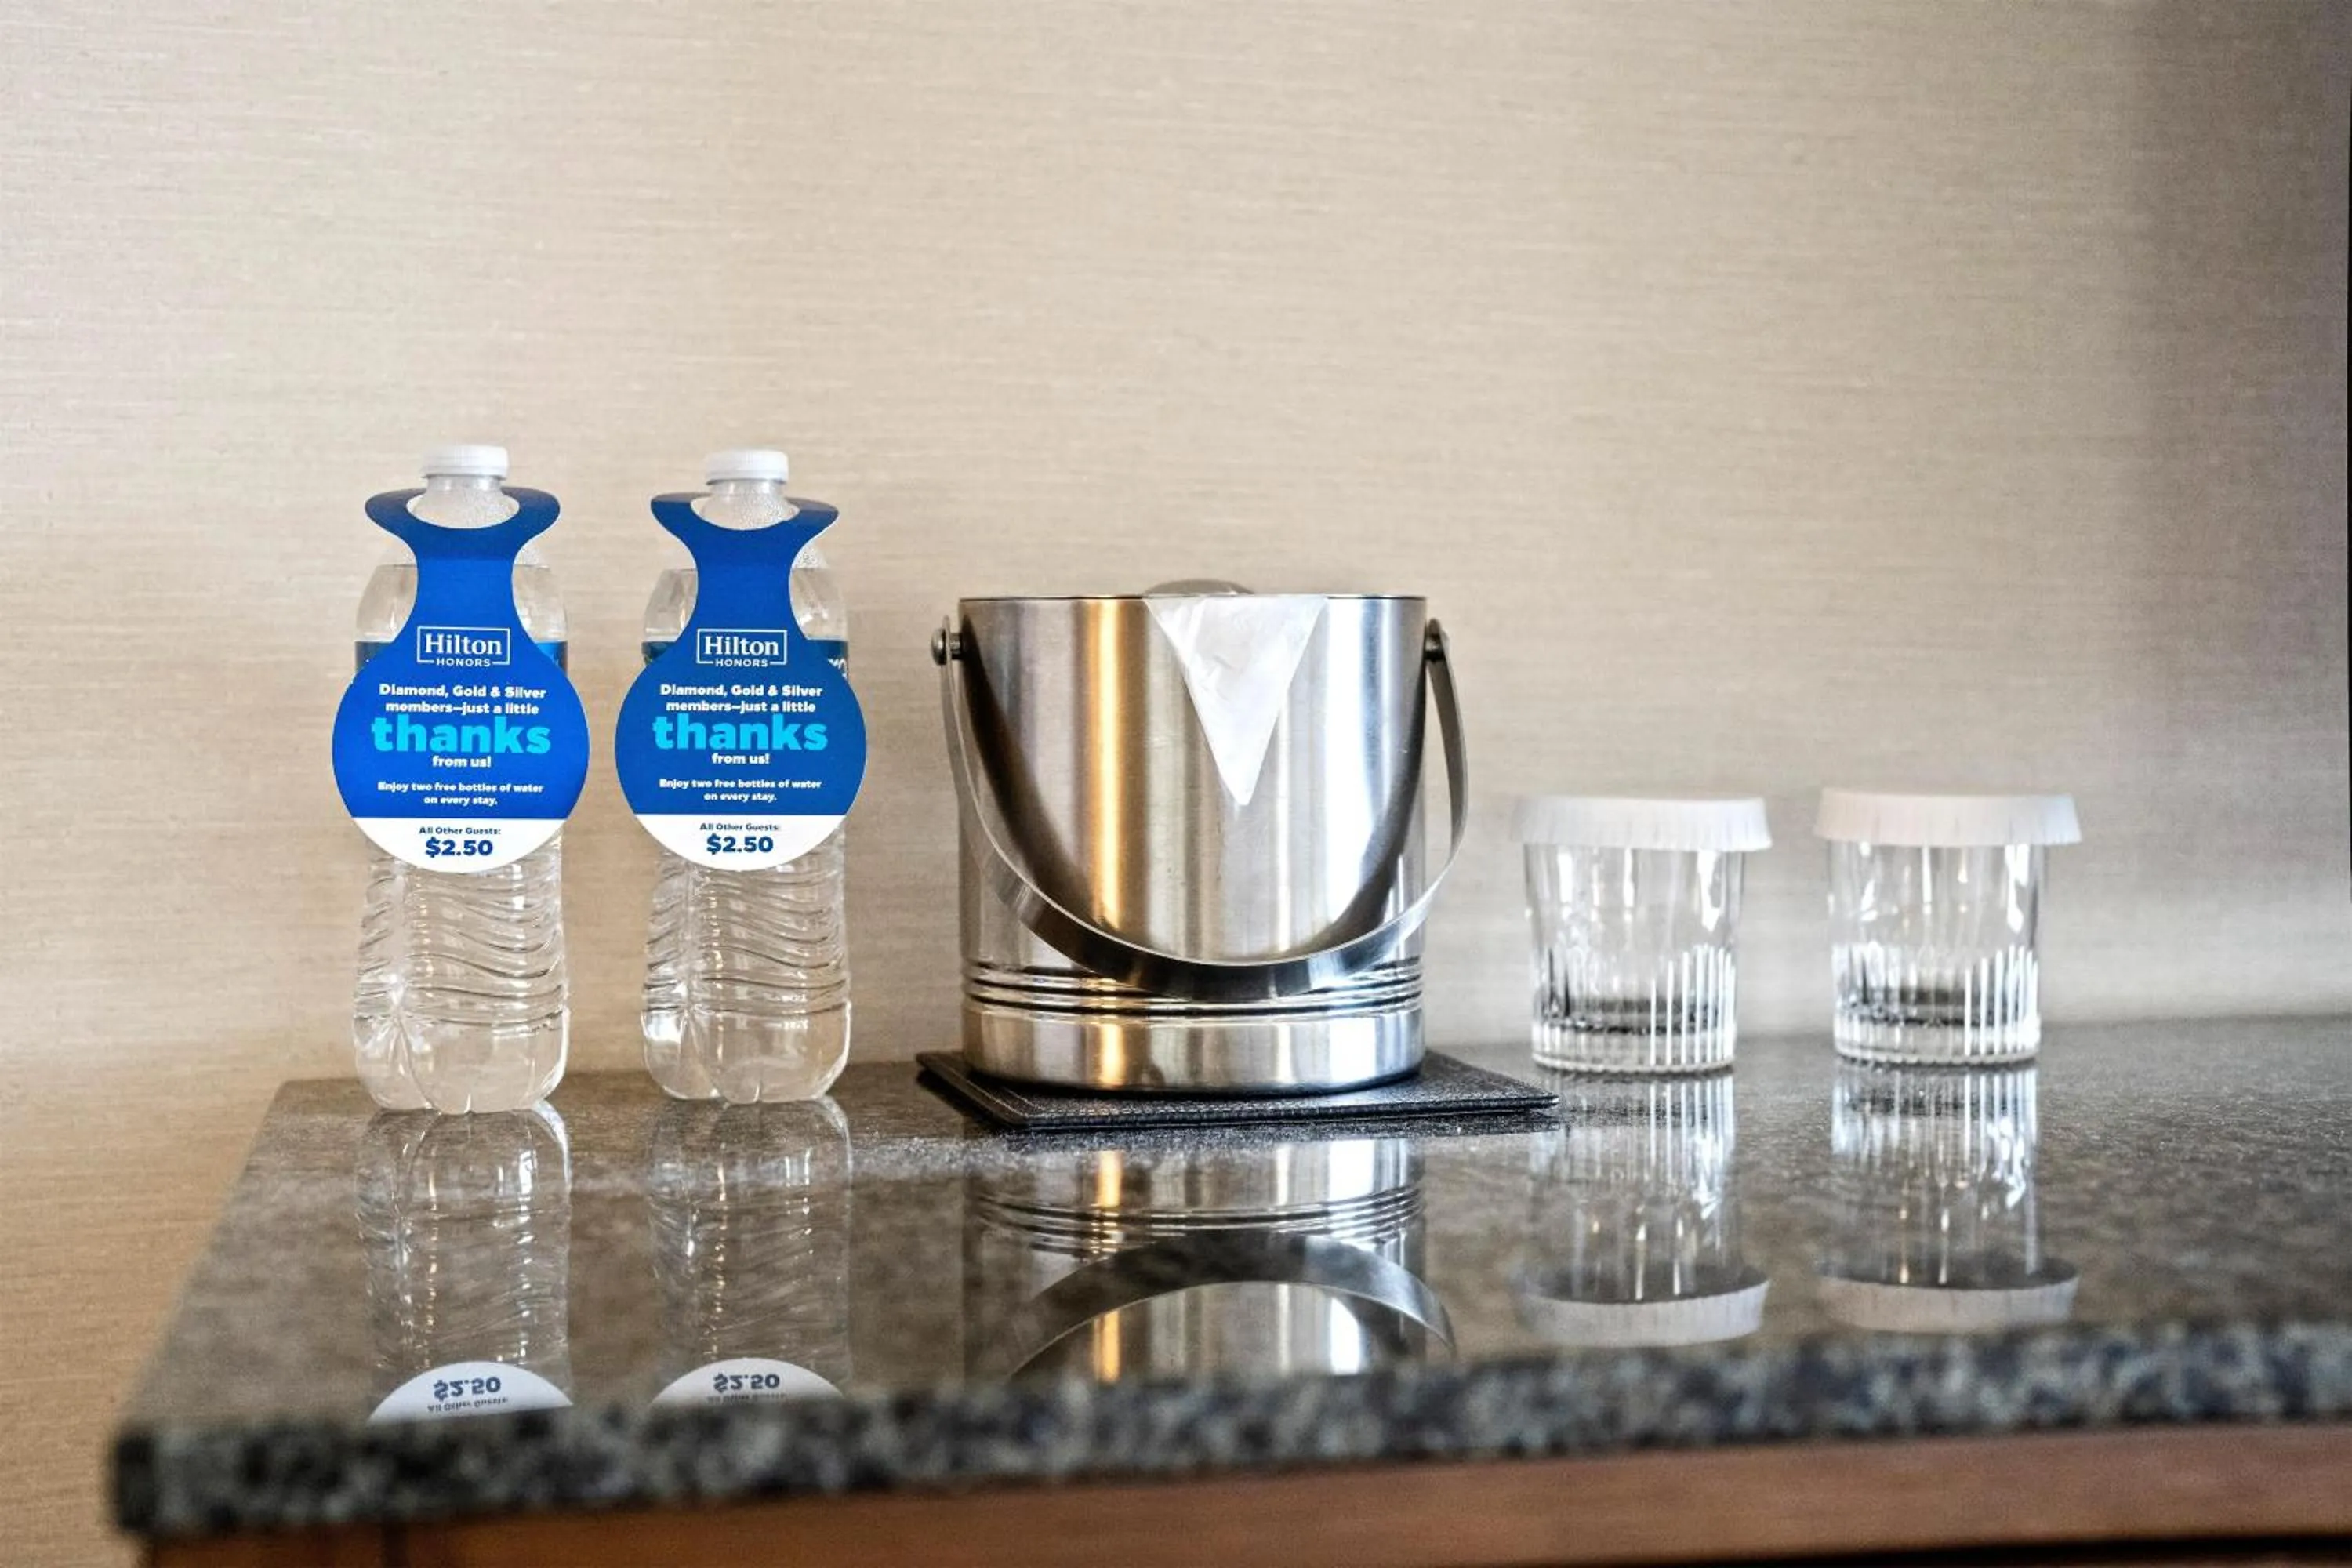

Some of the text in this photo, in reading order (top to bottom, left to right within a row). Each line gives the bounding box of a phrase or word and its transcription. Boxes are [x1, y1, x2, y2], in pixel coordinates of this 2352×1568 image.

[425, 634, 502, 655] Hilton
[705, 637, 779, 655] Hilton
[437, 659, 491, 667] HONORS
[716, 659, 768, 667] HONORS
[379, 684, 546, 699] Diamond, Gold & Silver
[660, 684, 822, 697] Diamond, Gold & Silver
[506, 703, 539, 714] little
[782, 702, 815, 712] little
[371, 714, 551, 753] thanks
[652, 713, 828, 750] thanks
[432, 756, 492, 768] from us!
[712, 753, 769, 764] from us!
[378, 782, 408, 793] Enjoy
[459, 783, 497, 792] bottles
[659, 779, 689, 790] Enjoy
[441, 797, 469, 806] every
[472, 797, 498, 805] stay.
[720, 793, 748, 803] every
[752, 793, 776, 802] stay.
[426, 837, 493, 858] $2.50
[706, 833, 773, 855] $2.50
